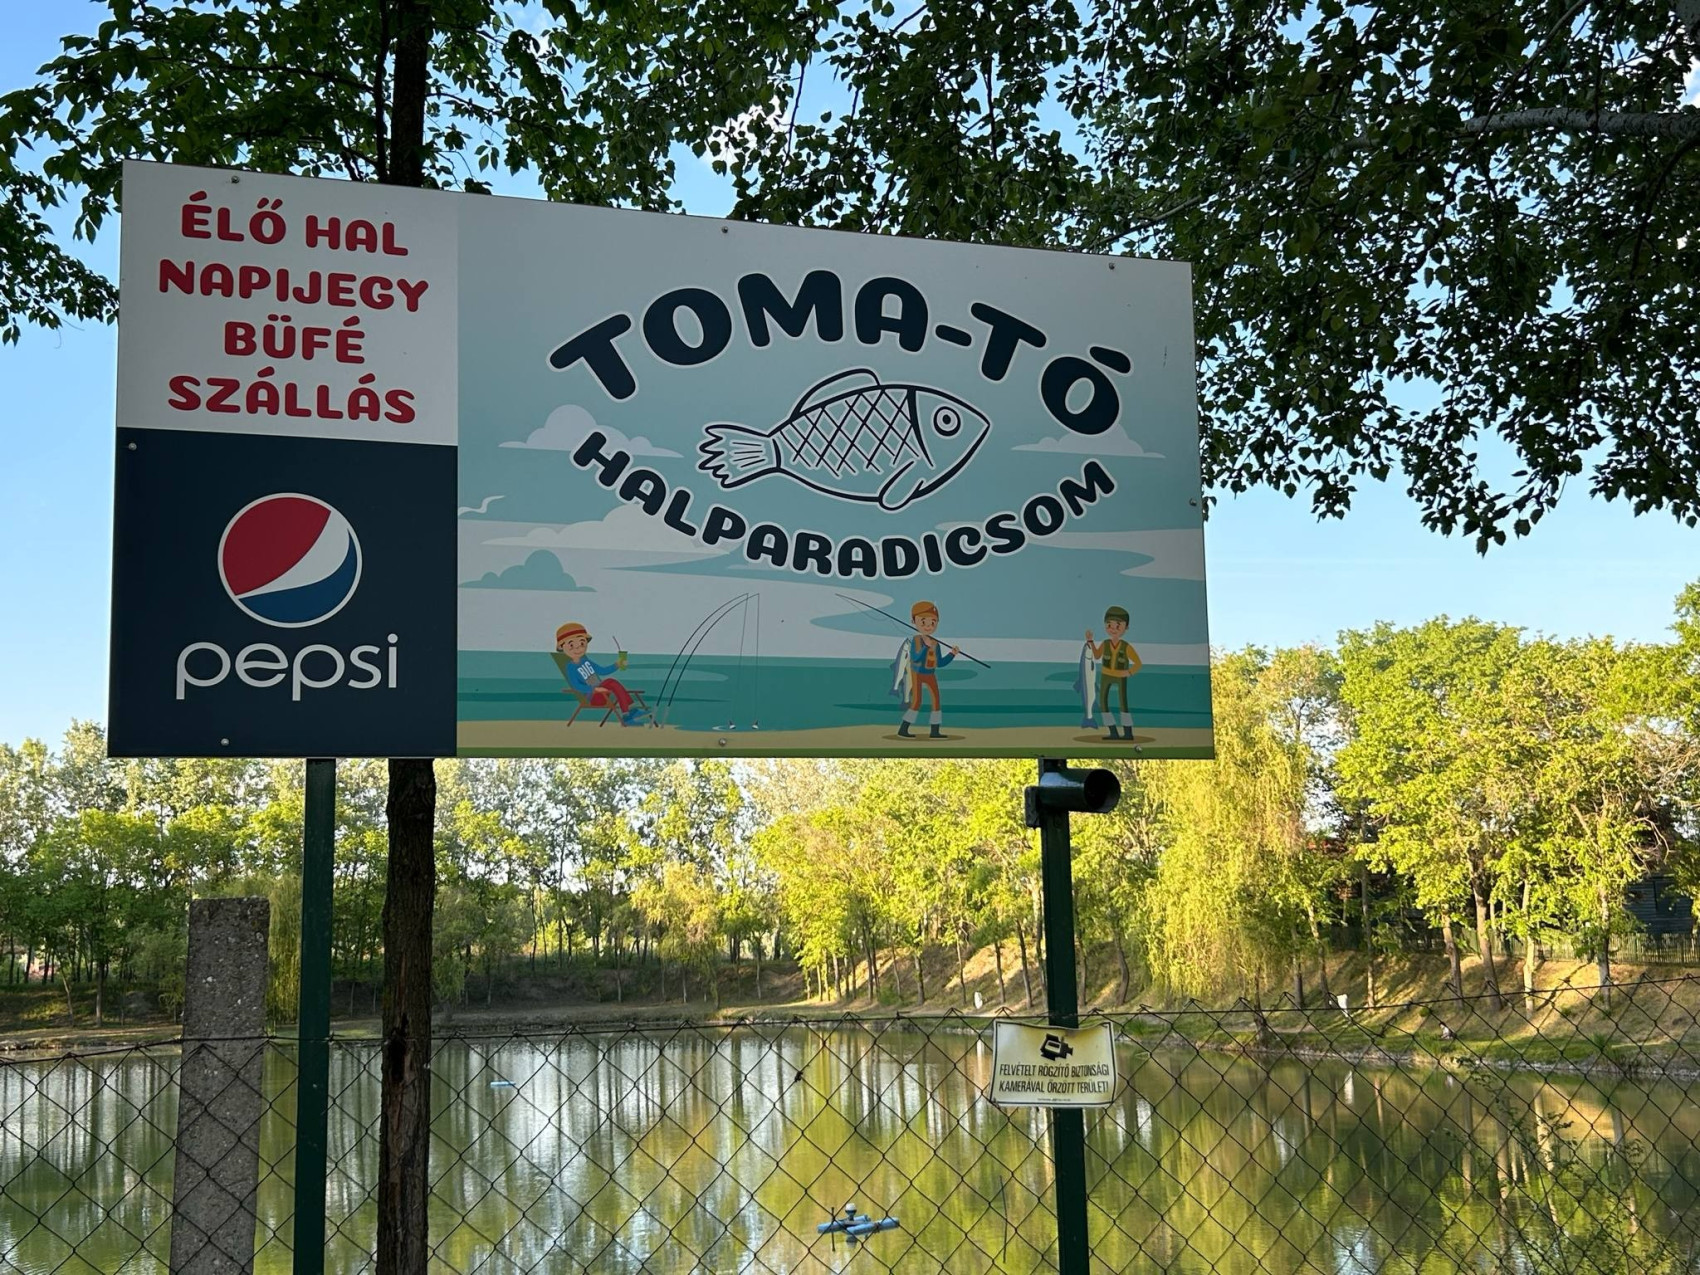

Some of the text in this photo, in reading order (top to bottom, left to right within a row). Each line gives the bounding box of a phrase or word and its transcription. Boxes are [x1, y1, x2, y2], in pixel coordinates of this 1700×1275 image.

[181, 190, 409, 257] ÉLŐ HAL
[159, 258, 429, 312] NAPIJEGY
[224, 313, 366, 364] BÜFÉ
[548, 269, 1132, 436] TOMA-TÓ
[168, 366, 416, 424] SZÁLLÁS
[572, 431, 1117, 578] HALPARADICSOM
[175, 633, 399, 702] pepsi
[577, 660, 596, 680] BIG
[998, 1078, 1045, 1093] KAMERÁVAL
[999, 1062, 1036, 1076] FELVÉTELT
[1071, 1061, 1110, 1078] BIZTONSÁGI
